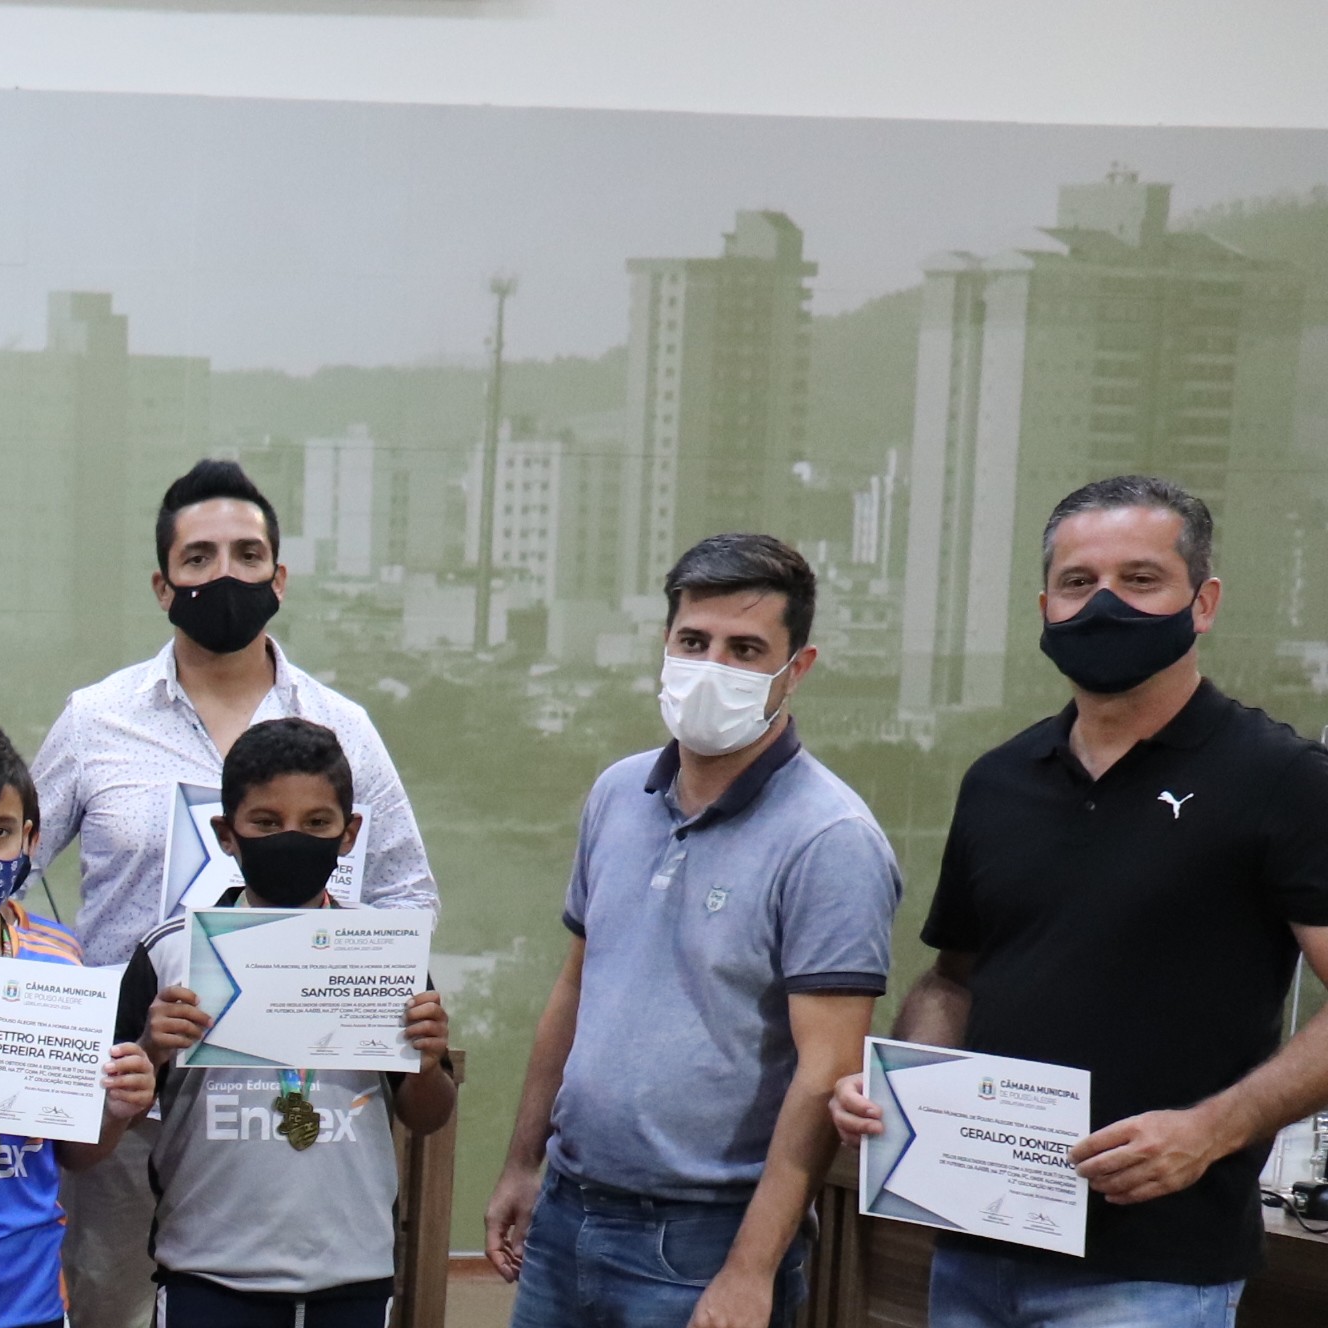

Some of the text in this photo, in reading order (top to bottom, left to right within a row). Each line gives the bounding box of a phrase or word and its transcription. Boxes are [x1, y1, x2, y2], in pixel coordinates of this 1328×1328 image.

[334, 928, 371, 936] CÂMARA
[329, 975, 415, 985] BRAIAN RUAN
[25, 981, 107, 999] CÂMARA MUNICIPAL
[301, 987, 414, 997] SANTOS BARBOSA
[38, 1035, 100, 1052] HENRIQUE
[49, 1049, 99, 1064] FRANCO
[206, 1079, 320, 1092] Grupo Educaal
[1036, 1086, 1081, 1100] MUNICIPAL
[960, 1127, 1073, 1155] GERALDO DONIZET
